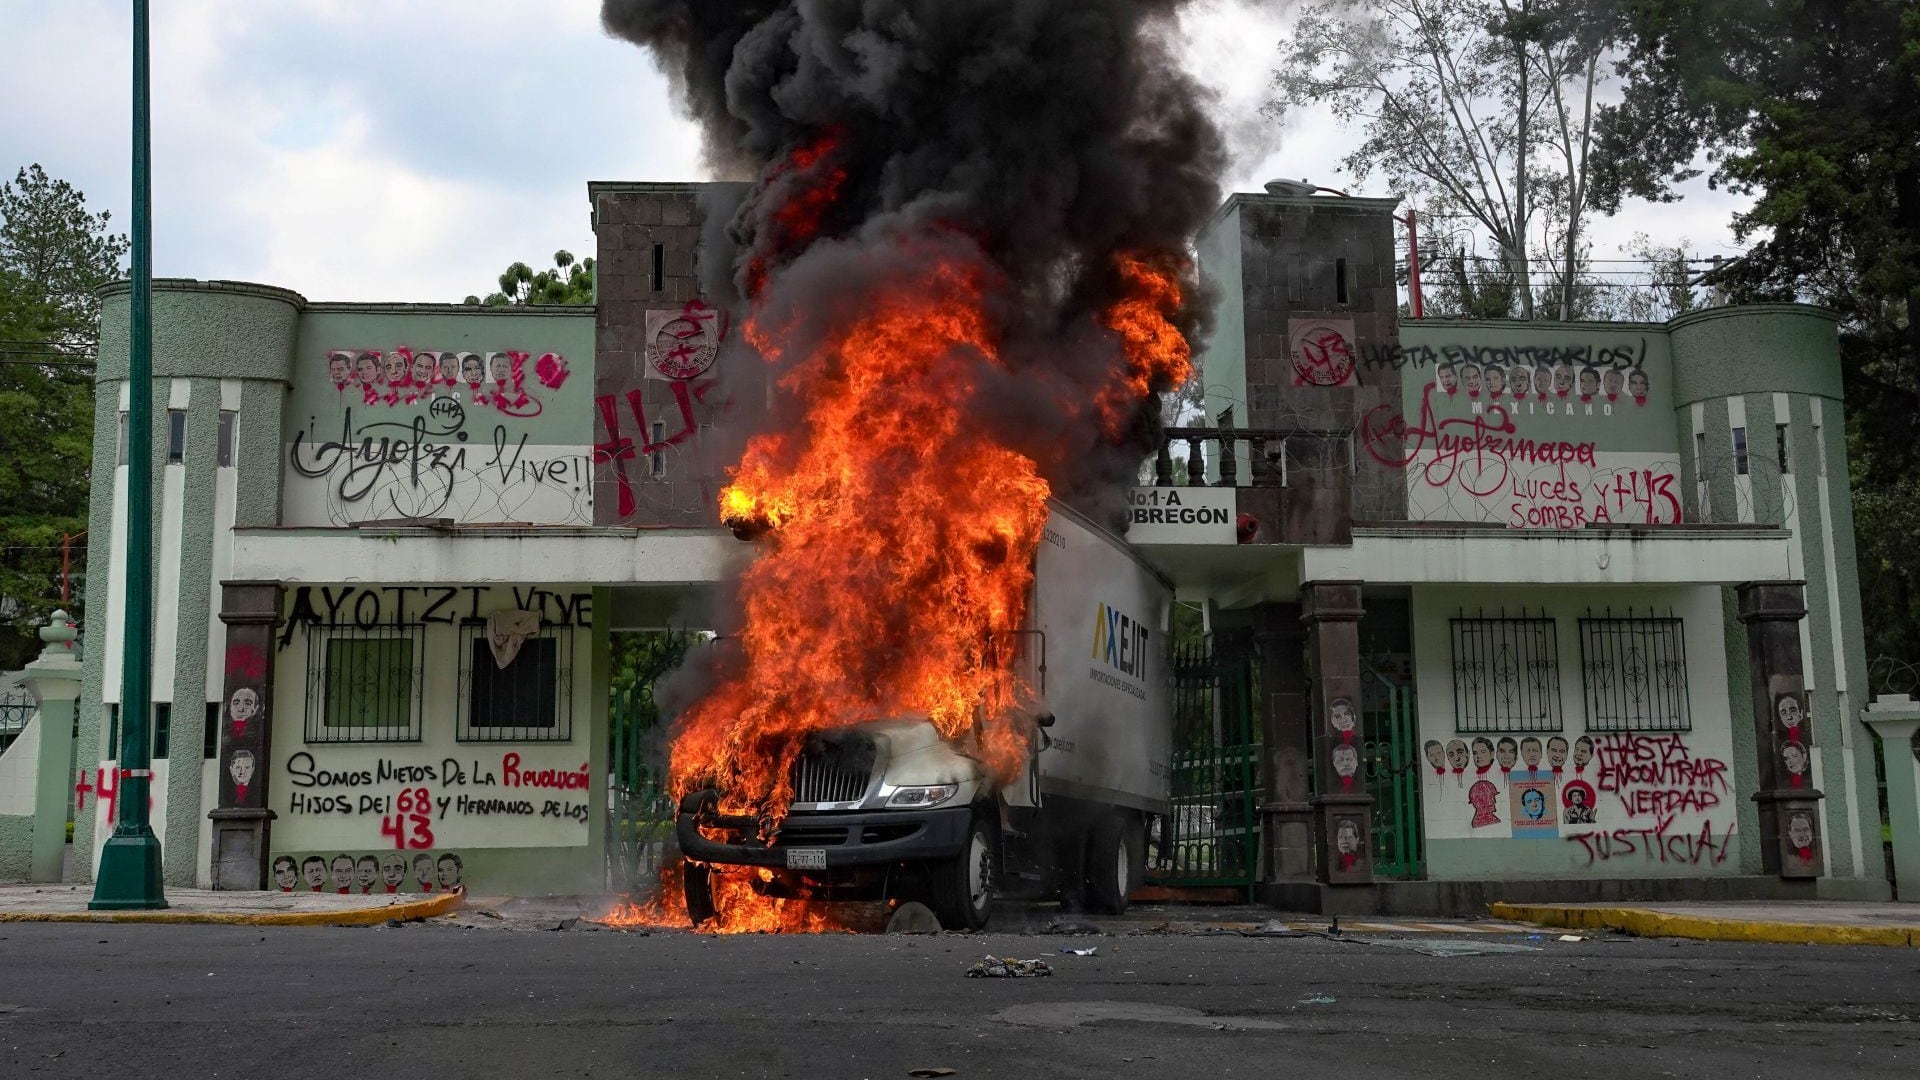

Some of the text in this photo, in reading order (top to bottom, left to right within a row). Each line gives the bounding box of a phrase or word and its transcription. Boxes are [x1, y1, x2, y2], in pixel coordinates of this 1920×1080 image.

[1471, 402, 1613, 417] MEXICANO
[1510, 503, 1612, 530] SOMBRA
[278, 586, 592, 652] AYOTZI VIVE
[1597, 758, 1729, 795] ENCONTRAR
[290, 791, 352, 815] HIJOS
[396, 787, 432, 815] 68
[456, 794, 534, 816] HERMANOS
[1620, 788, 1720, 817] VERDAD
[381, 814, 435, 850] 43
